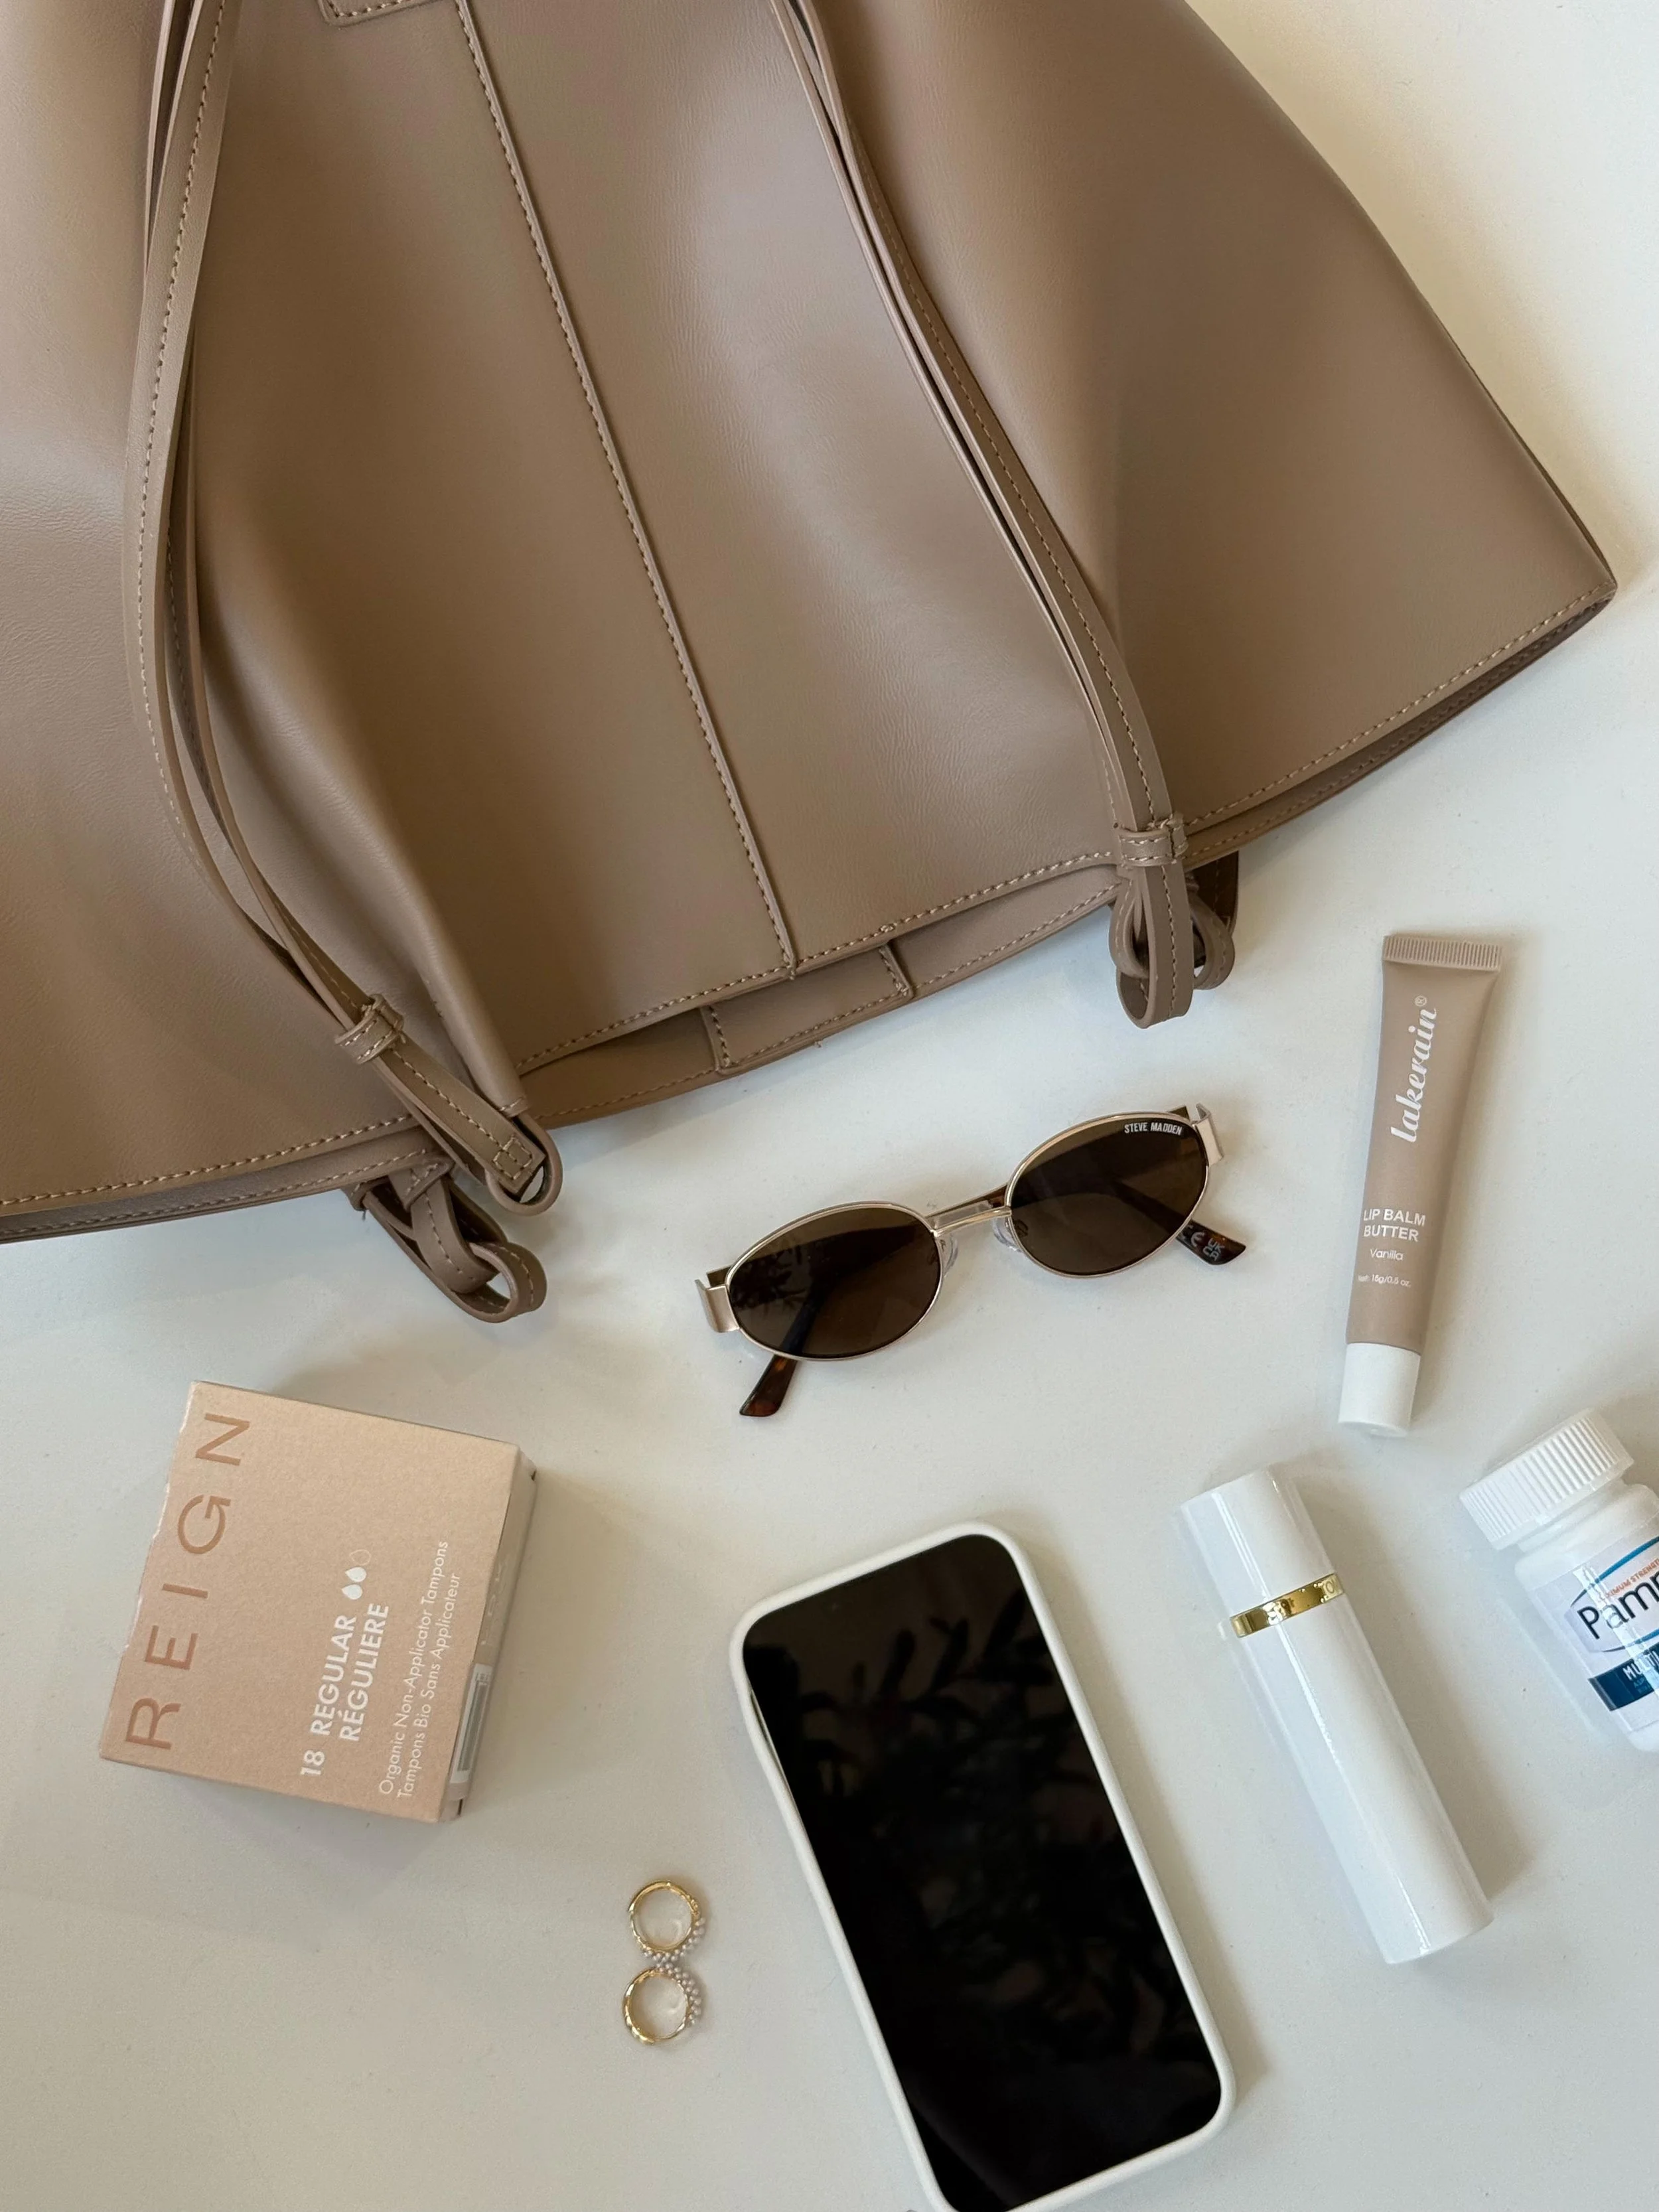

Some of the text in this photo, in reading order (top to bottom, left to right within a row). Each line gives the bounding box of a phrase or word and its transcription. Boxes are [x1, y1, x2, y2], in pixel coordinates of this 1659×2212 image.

[1124, 1122, 1183, 1136] STEVE MADDEN
[1363, 1209, 1426, 1226] LIP BALM
[1364, 1224, 1419, 1242] BUTTER
[1370, 1248, 1404, 1261] Vanilla
[124, 1412, 250, 1750] REIGN
[1600, 1580, 1631, 1600] XIMUM
[300, 1615, 356, 1775] 18 REGULAR
[336, 1603, 389, 1742] RÉGULIERE
[379, 1541, 448, 1794] Organic Non-Applicator Tampons
[396, 1573, 461, 1798] Tampons Bio Sans Applicateur
